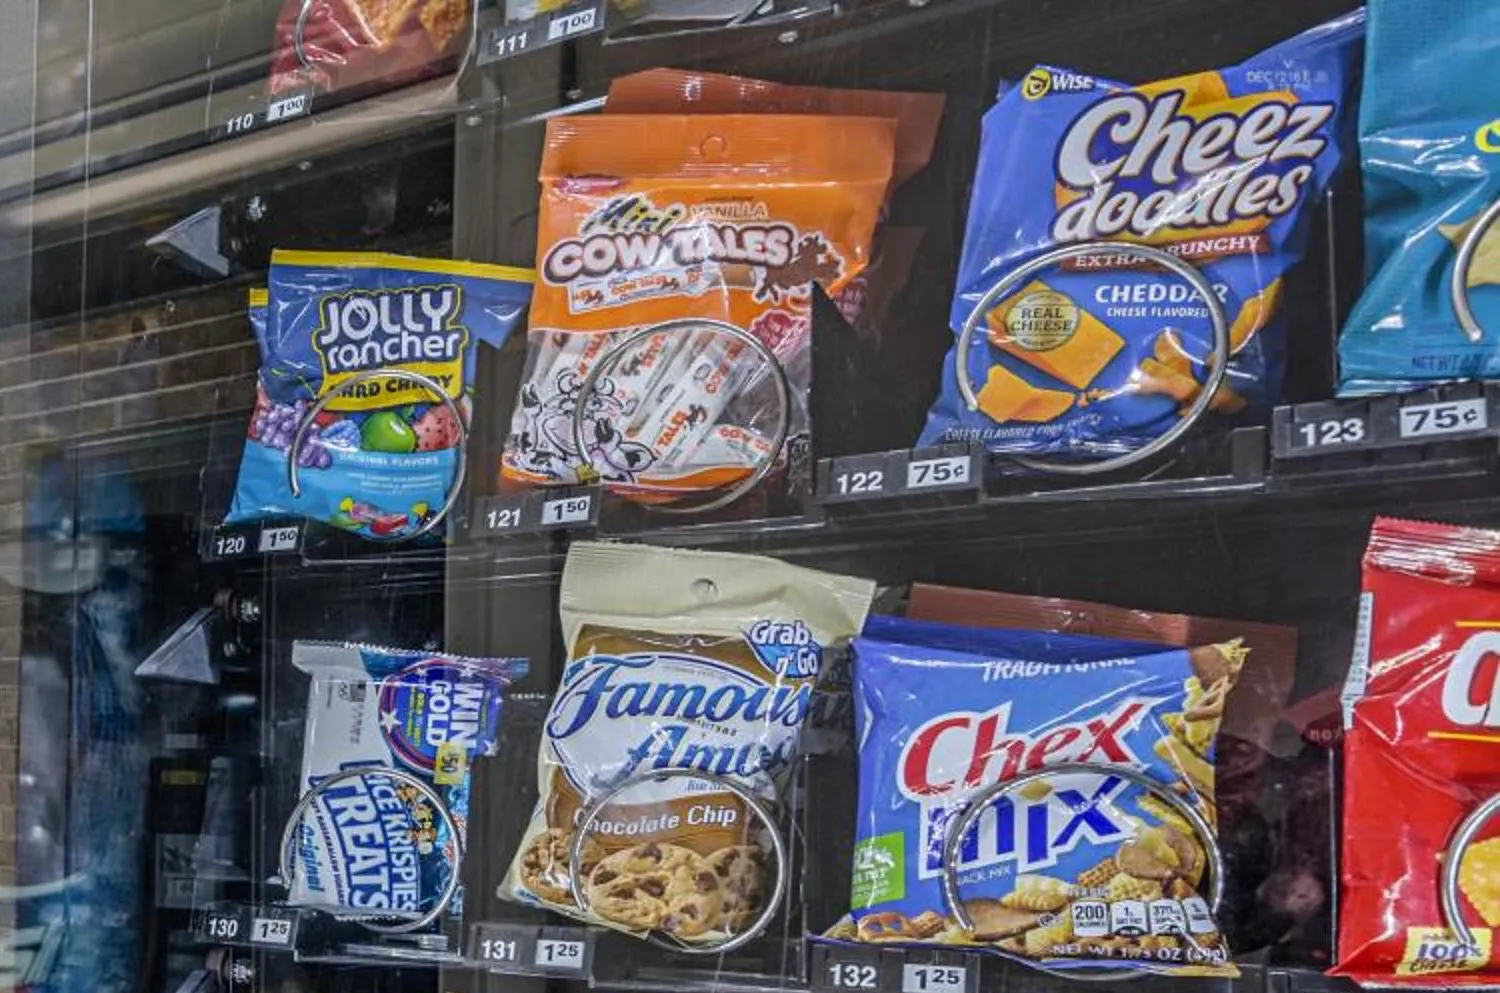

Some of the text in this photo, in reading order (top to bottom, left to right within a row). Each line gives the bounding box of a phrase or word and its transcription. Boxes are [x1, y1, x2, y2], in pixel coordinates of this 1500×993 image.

[496, 33, 528, 55] 111
[226, 113, 254, 133] 110
[1059, 92, 1334, 187] Cheez
[1053, 162, 1312, 243] doodles
[544, 232, 662, 284] COW
[666, 224, 795, 268] TALES
[1159, 235, 1262, 258] RUNCHY
[321, 289, 453, 345] JOLLY
[1010, 318, 1073, 333] CHEESE
[1021, 306, 1064, 320] REAL
[327, 331, 459, 372] rancher
[1301, 422, 1366, 448] 123
[836, 471, 884, 495] 122
[487, 508, 522, 529] 121
[217, 536, 246, 555] 120
[751, 621, 809, 646] Grab
[546, 654, 814, 740] Famous
[425, 680, 452, 747] GOLD
[450, 682, 485, 750] WIN
[902, 702, 1146, 797] Chex
[364, 775, 403, 811] ICE
[687, 804, 737, 826] Chip
[925, 774, 1134, 871] mix
[323, 775, 391, 909] TREATS
[302, 824, 326, 892] Original
[1074, 905, 1105, 921] 200
[208, 918, 237, 938] 130
[481, 941, 516, 961] 131
[829, 963, 877, 988] 132
